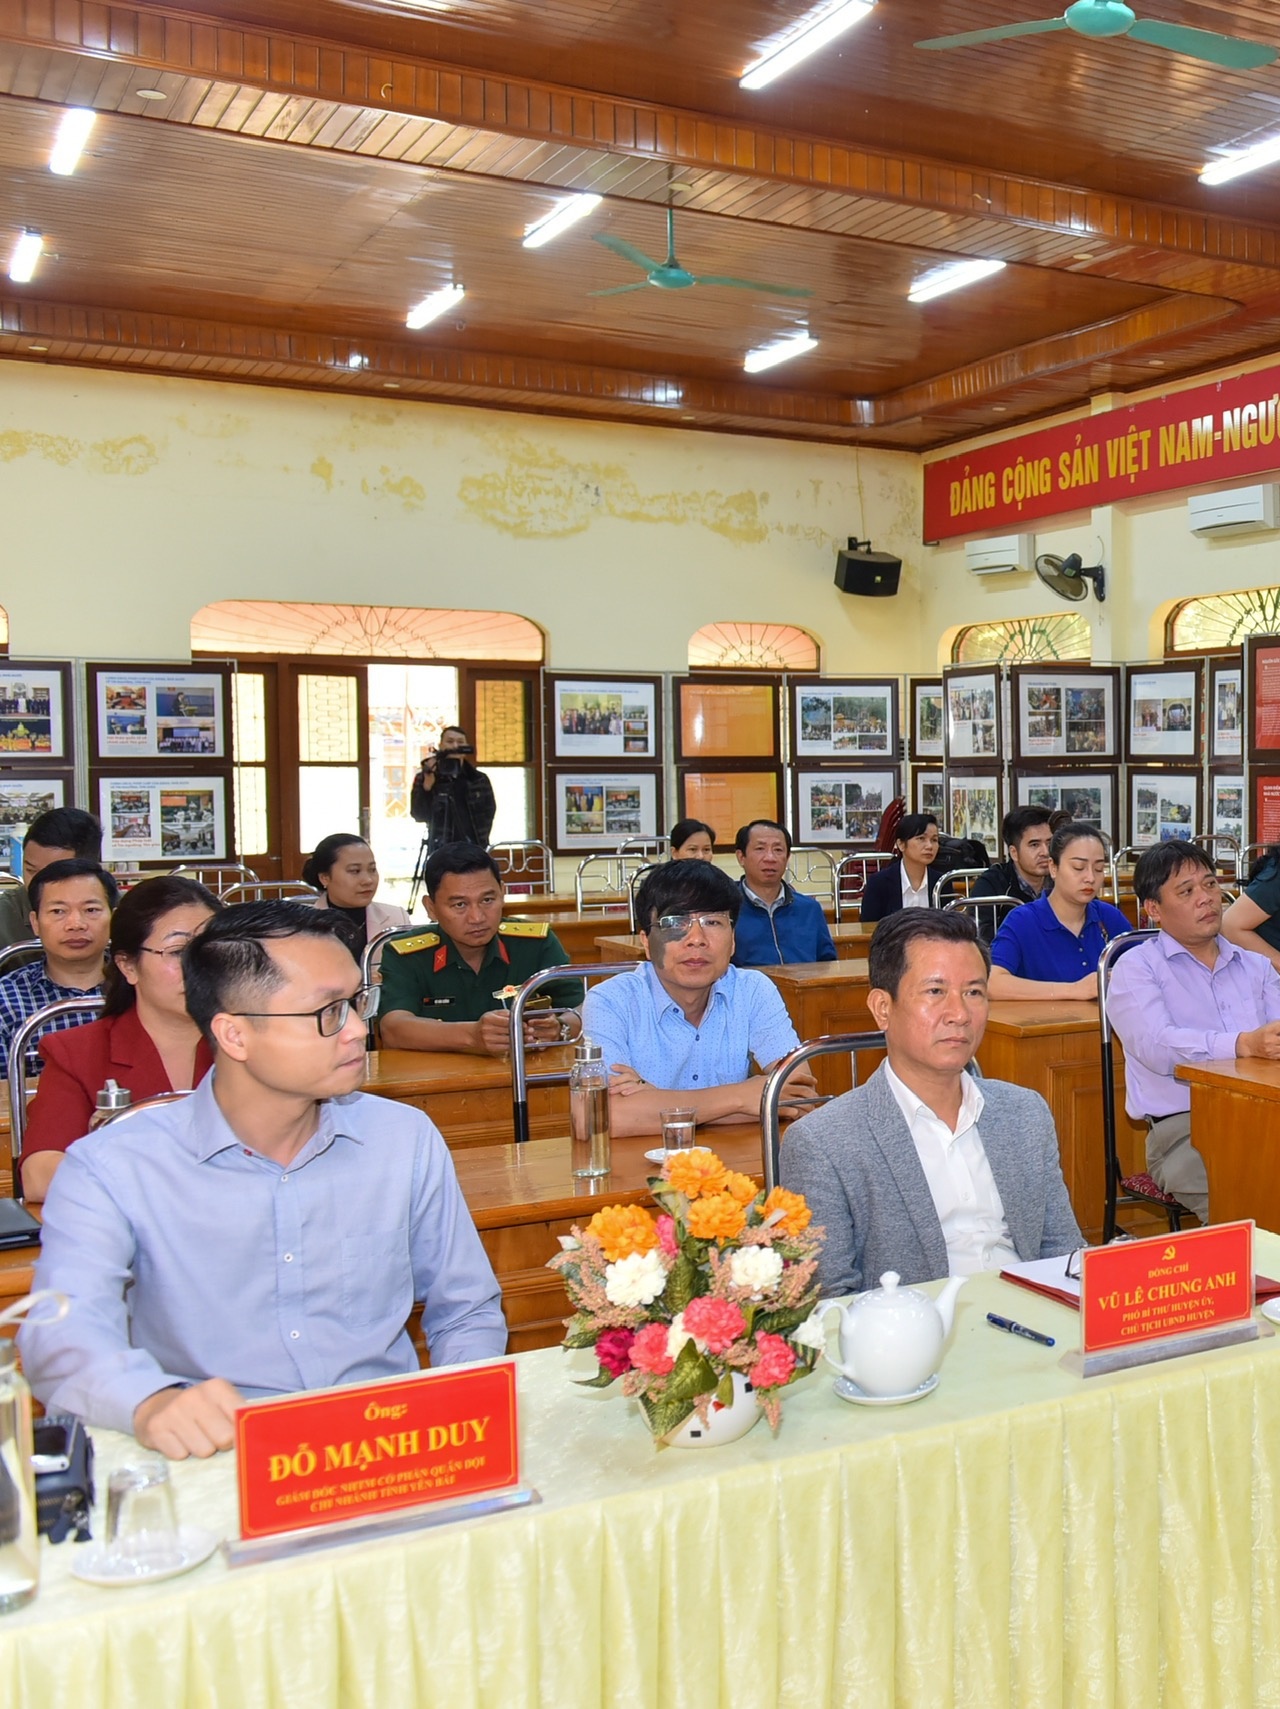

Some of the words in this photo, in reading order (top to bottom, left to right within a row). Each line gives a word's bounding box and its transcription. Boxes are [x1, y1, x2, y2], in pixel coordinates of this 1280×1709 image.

[950, 466, 996, 517] ĐẢNG
[1002, 456, 1051, 511] CỘNG
[1058, 434, 1100, 490] SẢN
[1106, 425, 1152, 484] VIỆT
[1147, 1265, 1173, 1279] ĐỒNG
[1173, 1262, 1190, 1274] CHÍ
[1098, 1292, 1121, 1311] VŨ
[1124, 1285, 1145, 1307] LÊ
[1147, 1277, 1202, 1302] CHUNG
[1204, 1271, 1238, 1292] ANH
[1120, 1321, 1140, 1336] CHỦ
[1141, 1317, 1162, 1333] TỊCH
[1162, 1313, 1186, 1329] UBND
[1187, 1308, 1216, 1324] HUYỆN
[1122, 1309, 1141, 1323] PHÓ
[1152, 1302, 1171, 1316] THƯ
[1171, 1298, 1201, 1314] HUYỆN
[364, 1400, 408, 1422] Ông:
[268, 1442, 317, 1483] ĐỖ
[323, 1428, 421, 1473] MẠNH
[427, 1416, 492, 1452] DUY
